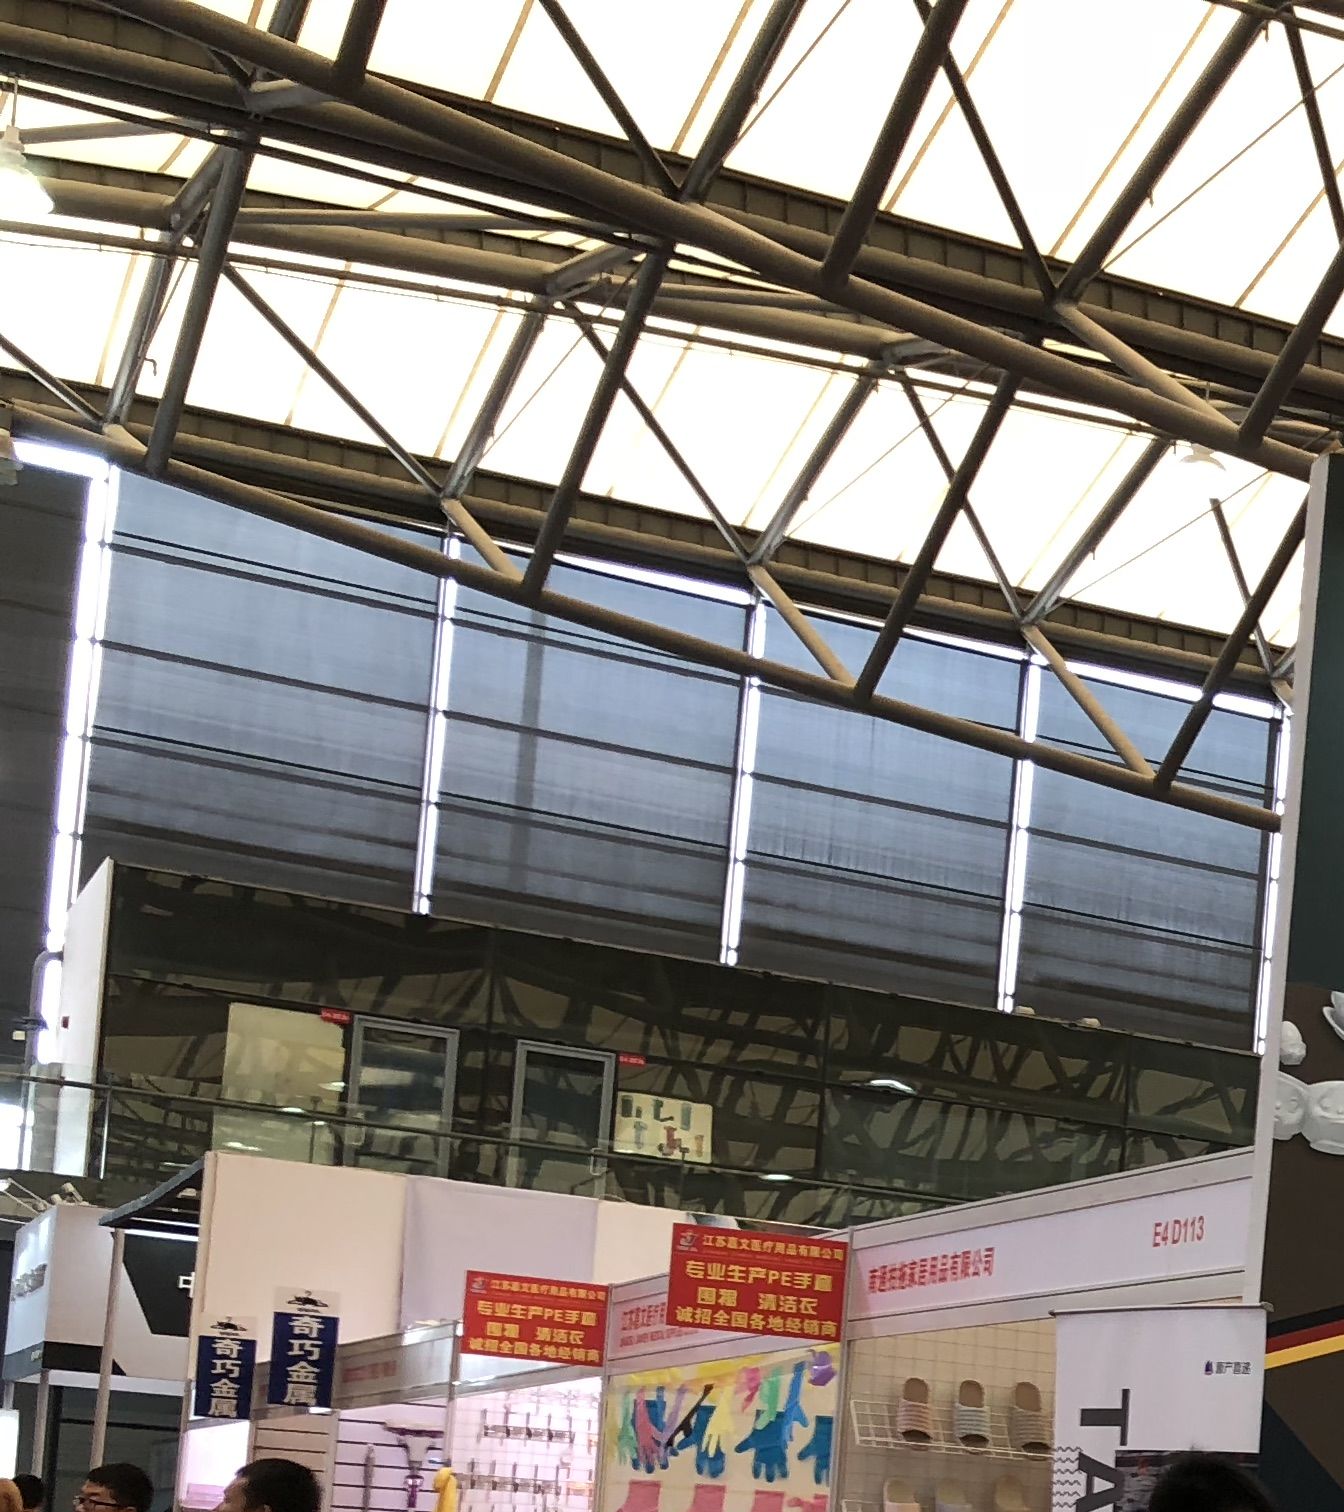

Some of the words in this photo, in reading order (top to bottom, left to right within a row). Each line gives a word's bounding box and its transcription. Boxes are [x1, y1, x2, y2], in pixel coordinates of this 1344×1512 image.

[208, 1338, 243, 1418] 奇巧金属
[284, 1316, 325, 1406] 奇巧金属
